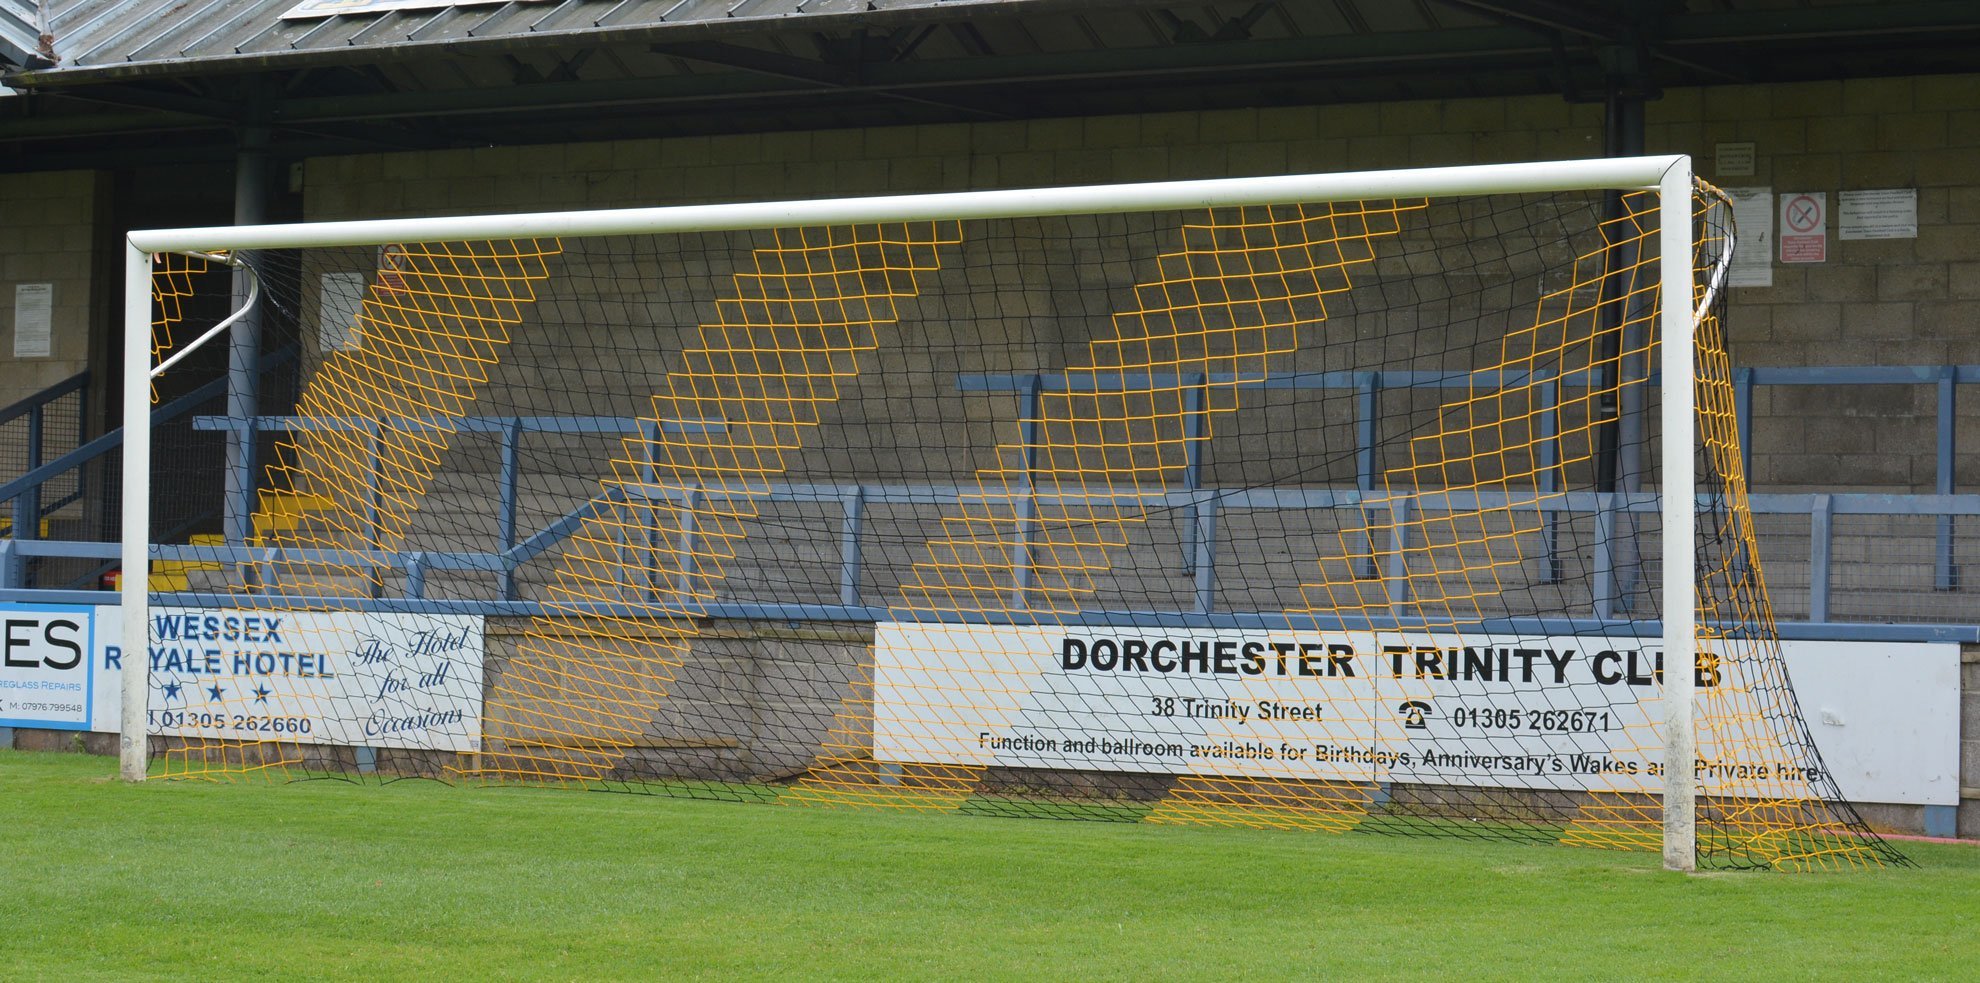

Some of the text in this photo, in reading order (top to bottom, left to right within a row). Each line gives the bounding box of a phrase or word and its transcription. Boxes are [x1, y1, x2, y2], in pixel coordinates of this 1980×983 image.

[155, 614, 284, 643] WESSEX
[4, 619, 82, 671] ES
[353, 626, 470, 667] The Hotel
[105, 645, 335, 678] RYALE HOTEL
[1062, 638, 1722, 688] DORCHESTER TRINITY CLB
[370, 661, 451, 704] for all
[22, 702, 48, 711] 07976
[49, 703, 83, 713] 799548
[162, 711, 226, 730] 01305
[234, 715, 312, 734] 262660
[365, 707, 463, 736] Occasions
[1151, 697, 1323, 725] 38 Trinity Street
[1454, 707, 1610, 733] 01305 262671
[979, 732, 1056, 752] Function
[1063, 737, 1095, 753] and
[1102, 737, 1184, 757] ballroom
[1190, 742, 1274, 761] available
[1280, 742, 1307, 761] for
[1315, 744, 1416, 770] Birthdays,
[1423, 749, 1562, 775] Anniversary's
[1571, 755, 1638, 776] Wakes
[1694, 760, 1769, 781] Private
